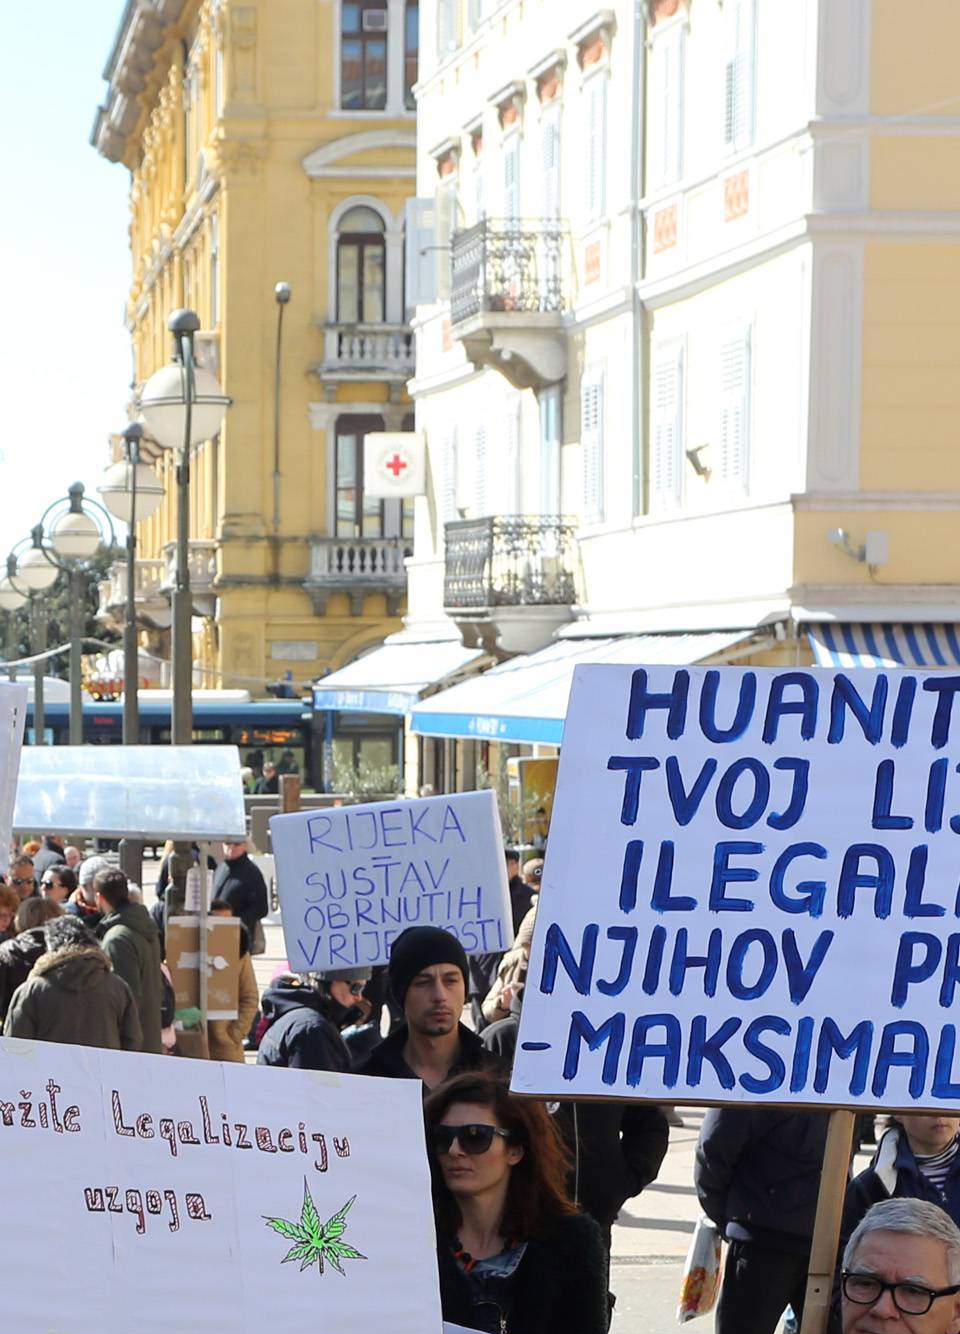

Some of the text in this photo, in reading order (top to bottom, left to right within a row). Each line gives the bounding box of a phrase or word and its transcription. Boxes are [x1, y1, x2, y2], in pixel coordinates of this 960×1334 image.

[607, 756, 810, 830] TVOJ
[306, 804, 467, 854] RIJEKA
[305, 858, 450, 903] SUSTAV
[618, 840, 960, 920] ILEGAL
[304, 886, 482, 932] OBRNUTIH
[540, 922, 834, 1005] NJIHOV
[84, 1186, 212, 1234] uzgoja
